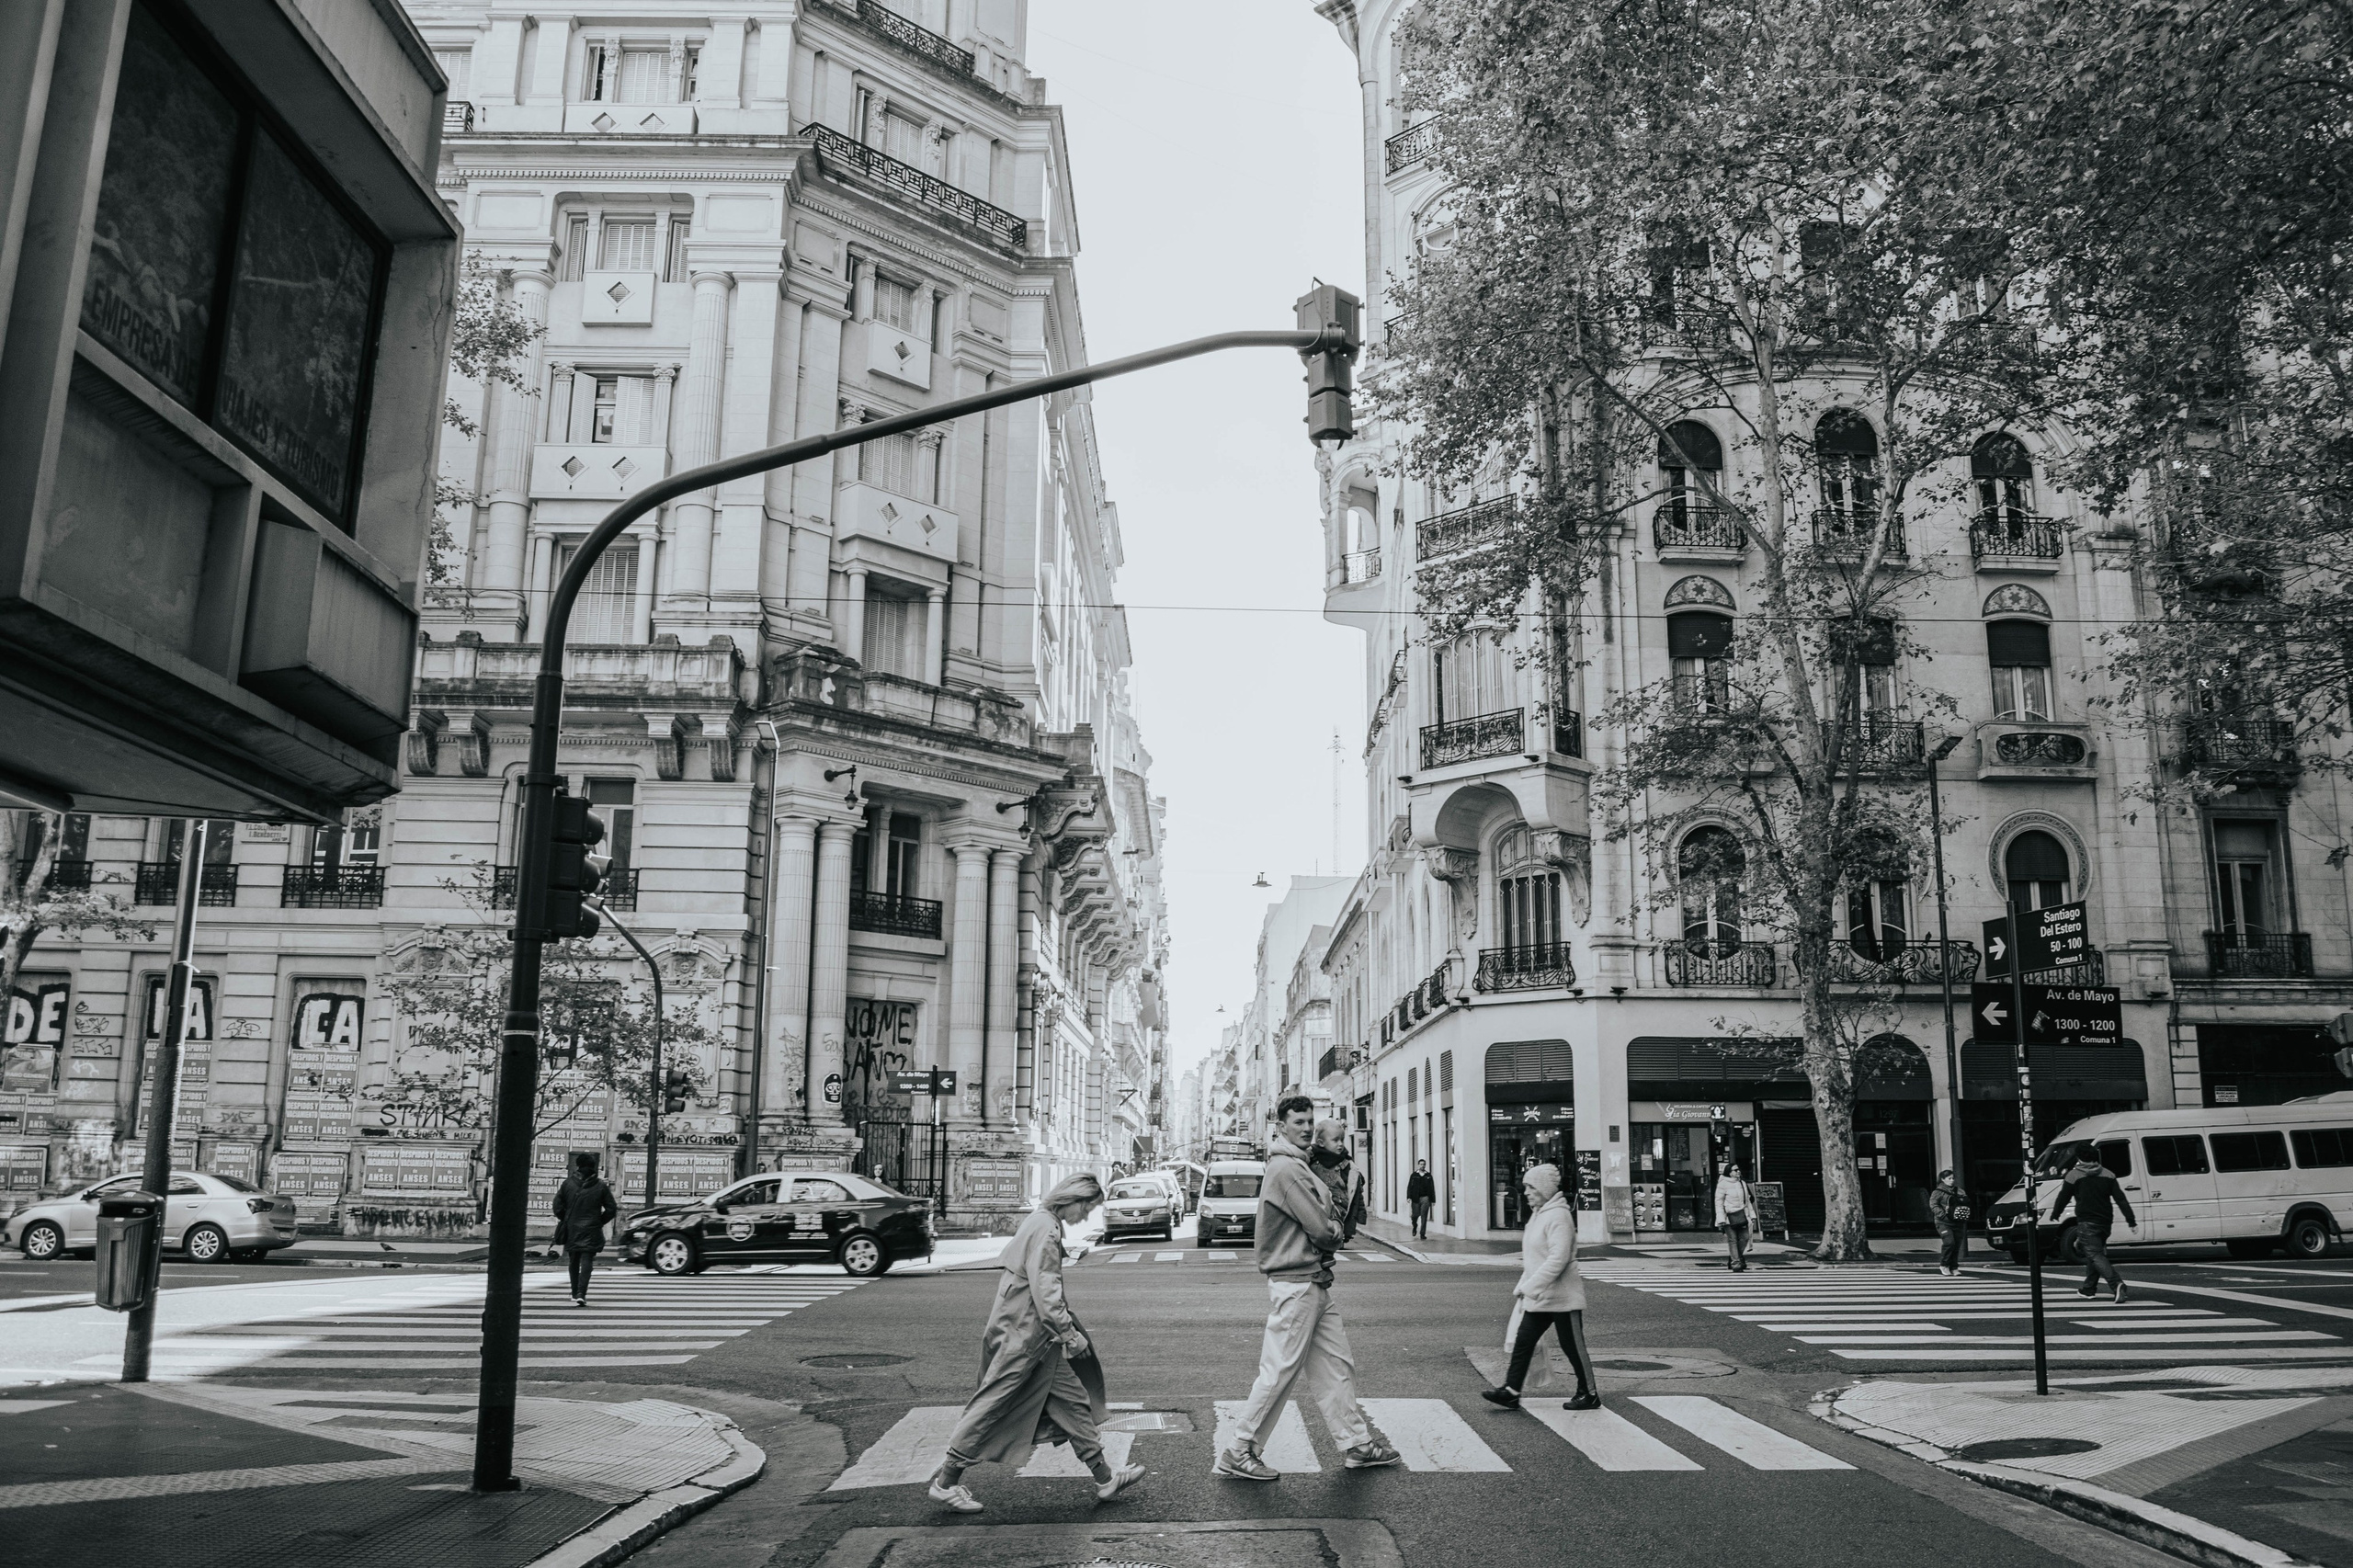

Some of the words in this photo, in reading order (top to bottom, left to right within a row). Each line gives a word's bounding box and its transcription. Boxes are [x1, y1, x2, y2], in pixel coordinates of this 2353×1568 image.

[90, 278, 173, 379] EMPRESA
[222, 374, 269, 445] VIAJES
[285, 427, 339, 502] TURISMO
[2043, 908, 2081, 923] Santiago
[2040, 926, 2054, 937] Del
[2055, 922, 2082, 935] Estero
[2051, 940, 2062, 952] 50
[2067, 937, 2082, 949] 100
[2055, 956, 2078, 965] Comuna
[2078, 953, 2083, 961] 1
[2046, 989, 2065, 1000] Av.
[2068, 989, 2081, 1000] de
[2084, 990, 2115, 1004] Mayo
[5, 991, 66, 1043] DE
[301, 999, 359, 1051] CA
[877, 1004, 913, 1046] ME
[2054, 1018, 2080, 1029] 1300
[2090, 1019, 2115, 1031] 1200
[2080, 1035, 2110, 1044] Comuna
[2112, 1036, 2116, 1044] 1
[327, 1077, 352, 1085] ANSES
[543, 1104, 569, 1112] ANSES
[577, 1105, 604, 1113] ANSES
[1681, 1110, 1711, 1120] Giovann
[288, 1125, 313, 1133] ANSES
[322, 1126, 347, 1134] ANSES
[540, 1153, 565, 1162] ANSES
[14, 1176, 39, 1184] ANSES
[368, 1174, 394, 1182] ANSES
[403, 1175, 428, 1183] ANSES
[438, 1175, 463, 1183] ANSES
[279, 1180, 305, 1188] ANSES
[313, 1181, 339, 1189] ANSES
[663, 1181, 689, 1189] ANSES
[698, 1181, 724, 1189] ANSES
[527, 1200, 552, 1210] ANSES
